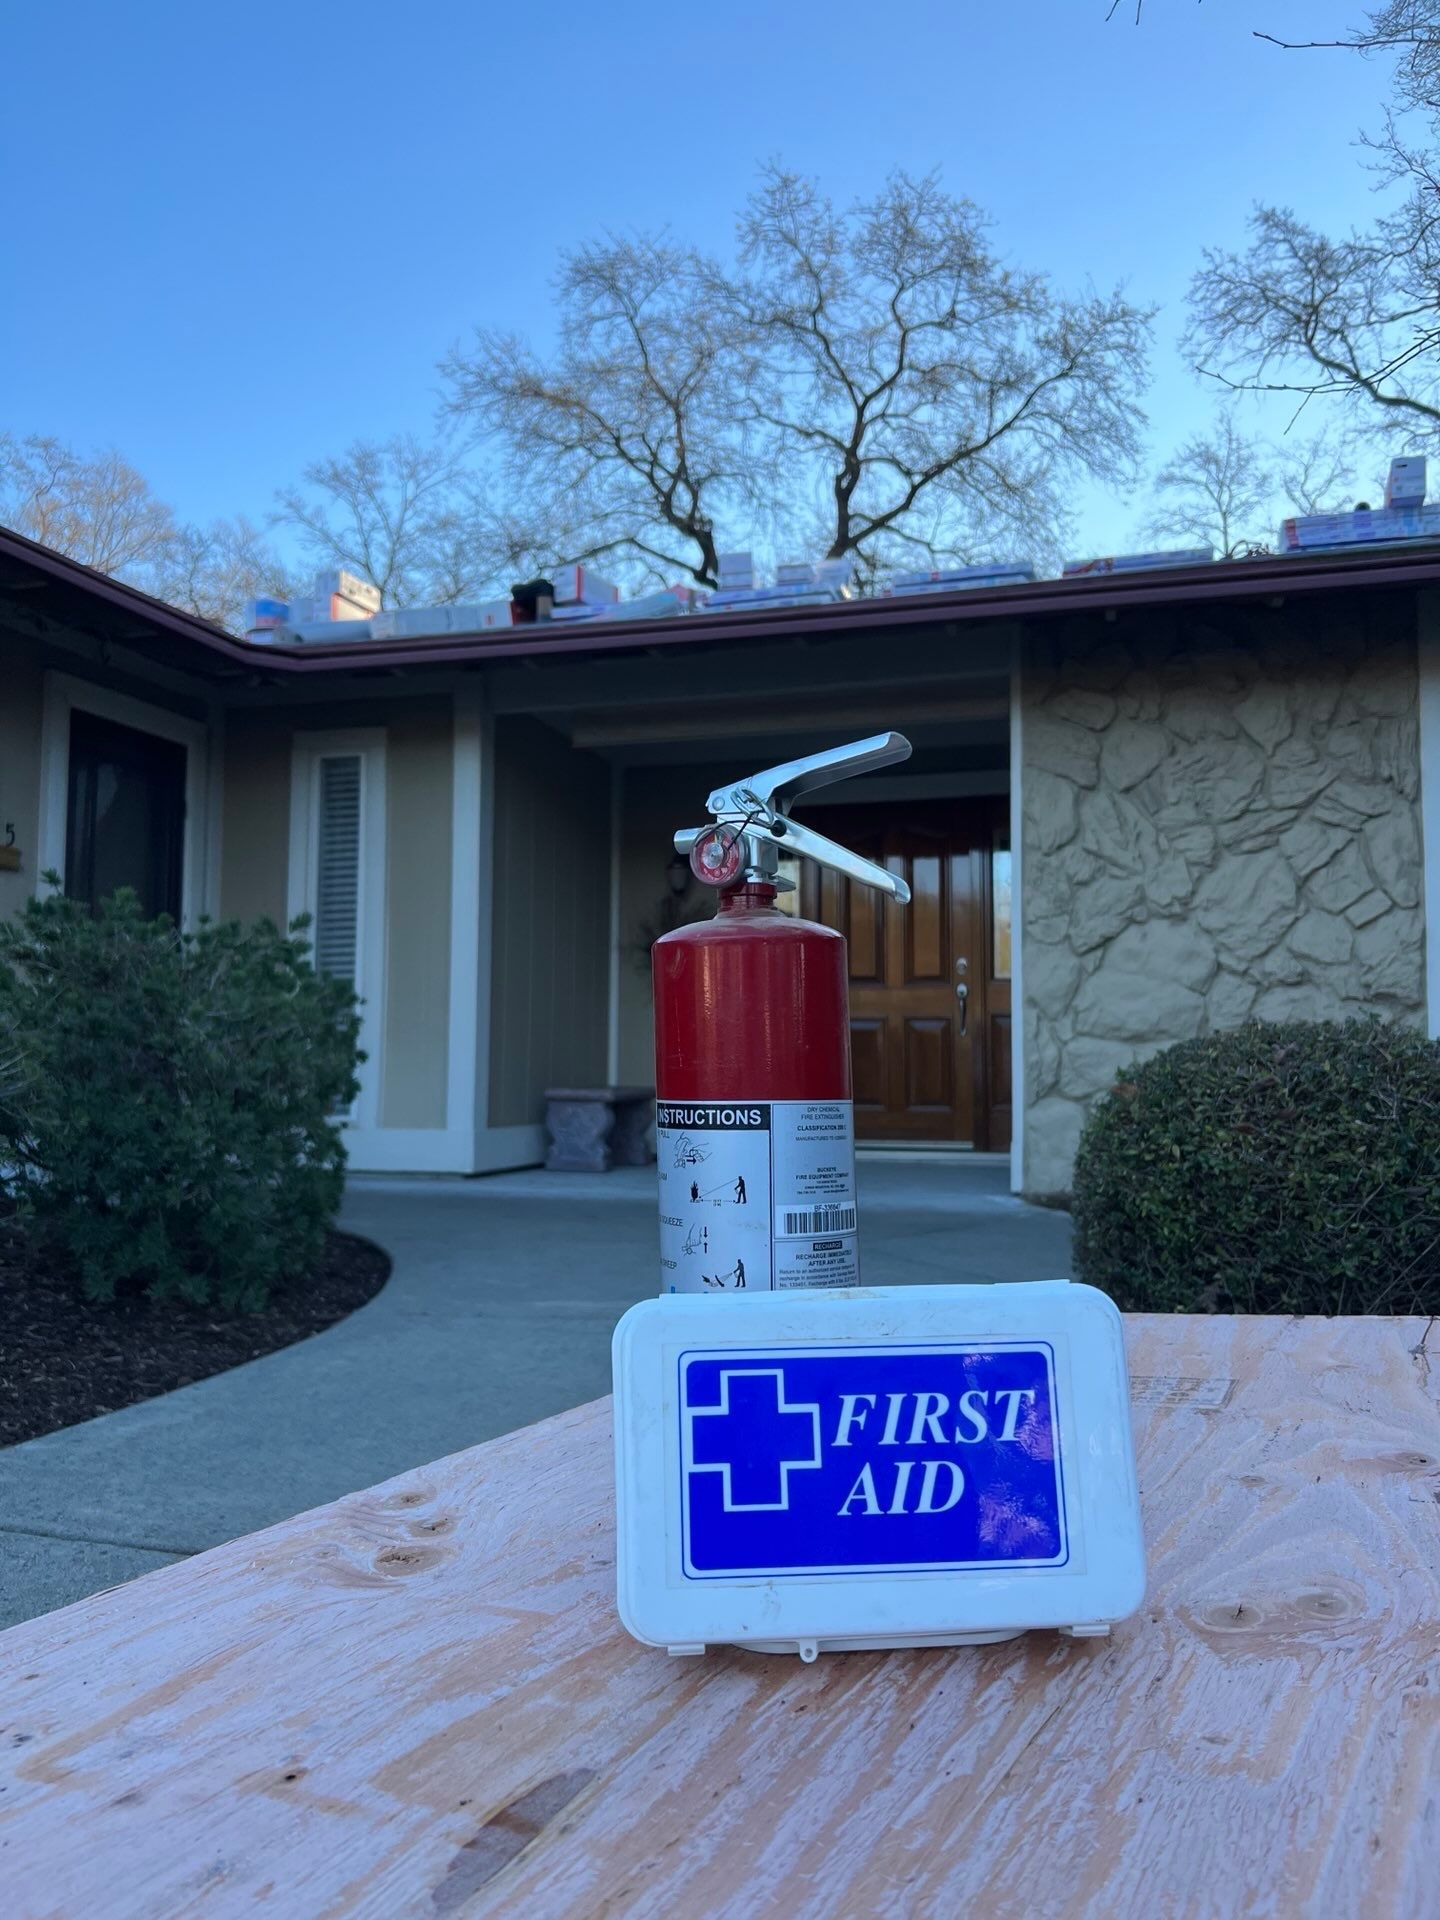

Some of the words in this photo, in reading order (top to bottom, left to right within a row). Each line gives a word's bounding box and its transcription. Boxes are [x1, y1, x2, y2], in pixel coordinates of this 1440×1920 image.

[658, 1108, 762, 1126] NSTRUCTIONS
[814, 1242, 842, 1250] RECHARGE
[831, 1388, 1035, 1447] FIRST
[837, 1460, 965, 1517] AID
